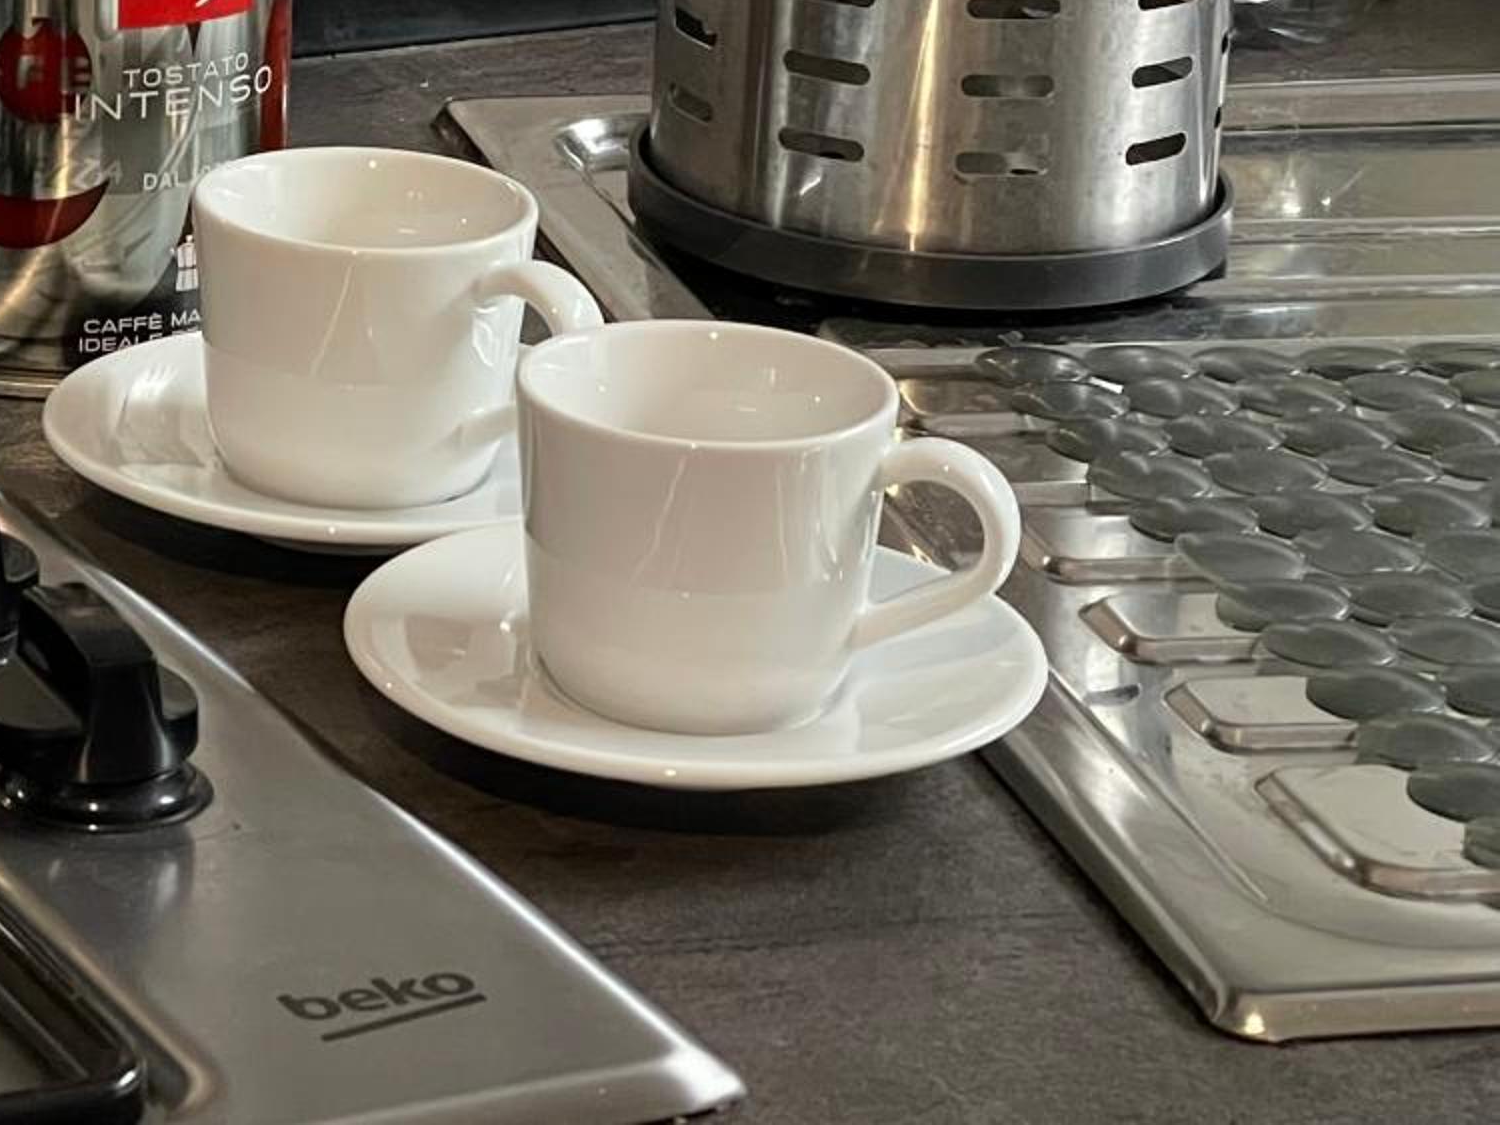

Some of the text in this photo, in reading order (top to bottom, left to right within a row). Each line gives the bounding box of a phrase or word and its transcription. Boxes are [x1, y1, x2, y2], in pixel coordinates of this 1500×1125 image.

[123, 52, 249, 88] TOSTATO
[75, 65, 272, 122] INTENSO
[143, 169, 186, 191] DAL
[277, 972, 476, 1021] beko
